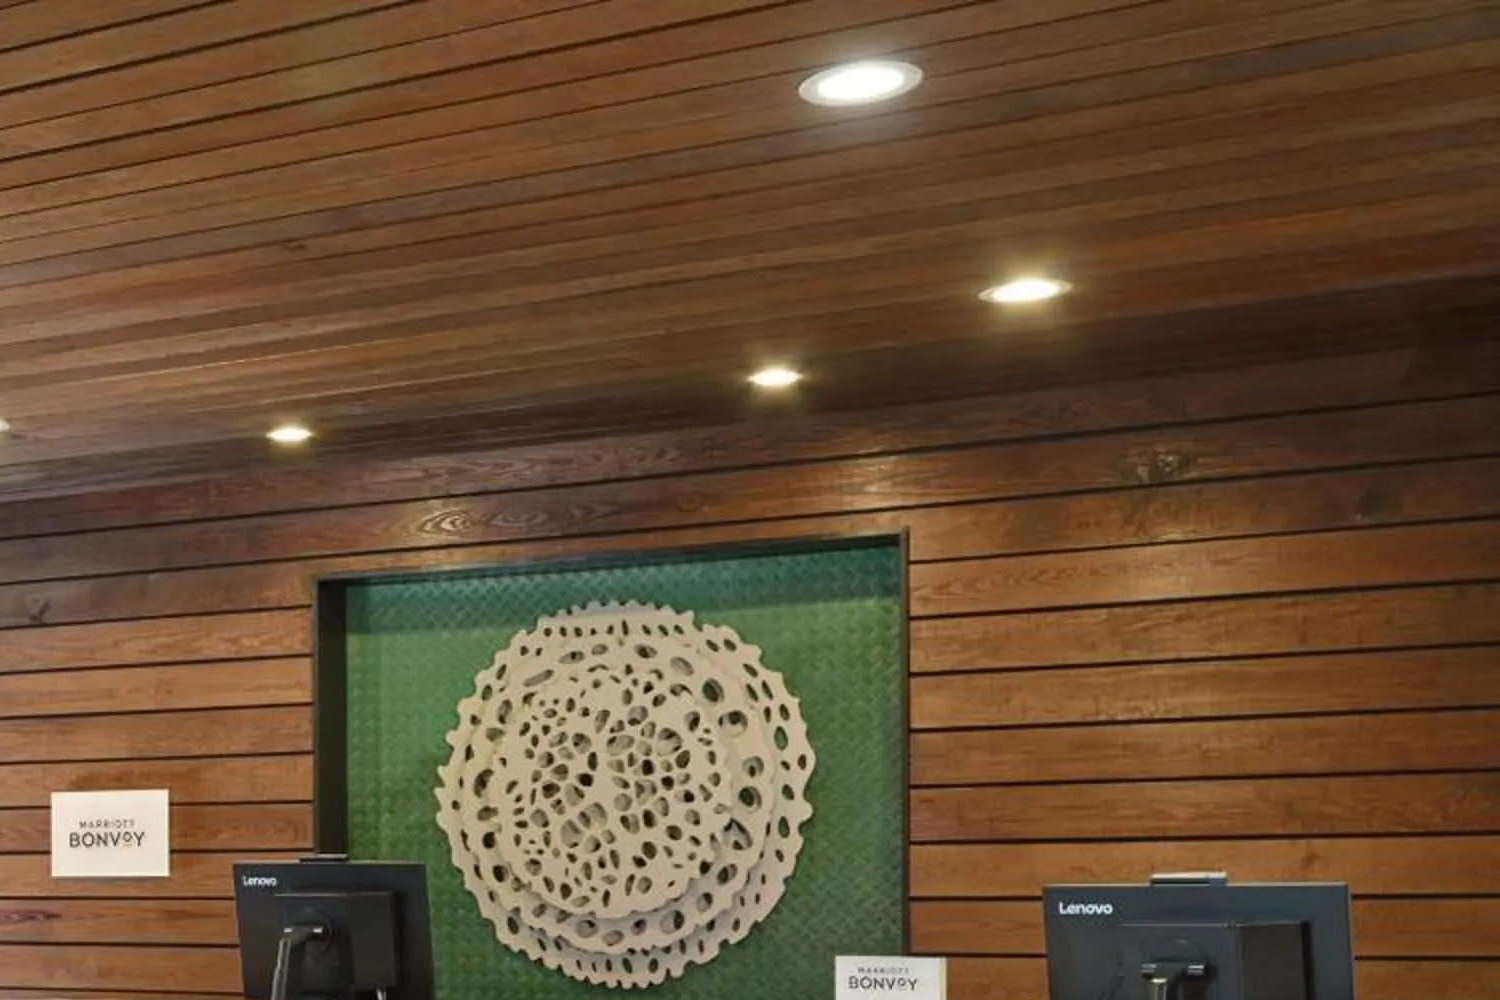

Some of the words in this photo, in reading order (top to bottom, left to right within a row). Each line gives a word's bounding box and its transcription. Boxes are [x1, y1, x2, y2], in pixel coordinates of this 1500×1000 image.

[79, 819, 135, 829] MARRIOTT
[69, 831, 145, 848] BONVOY
[242, 874, 278, 887] Lenovo
[1058, 901, 1114, 916] Lenovo
[848, 976, 918, 990] BONVOY
